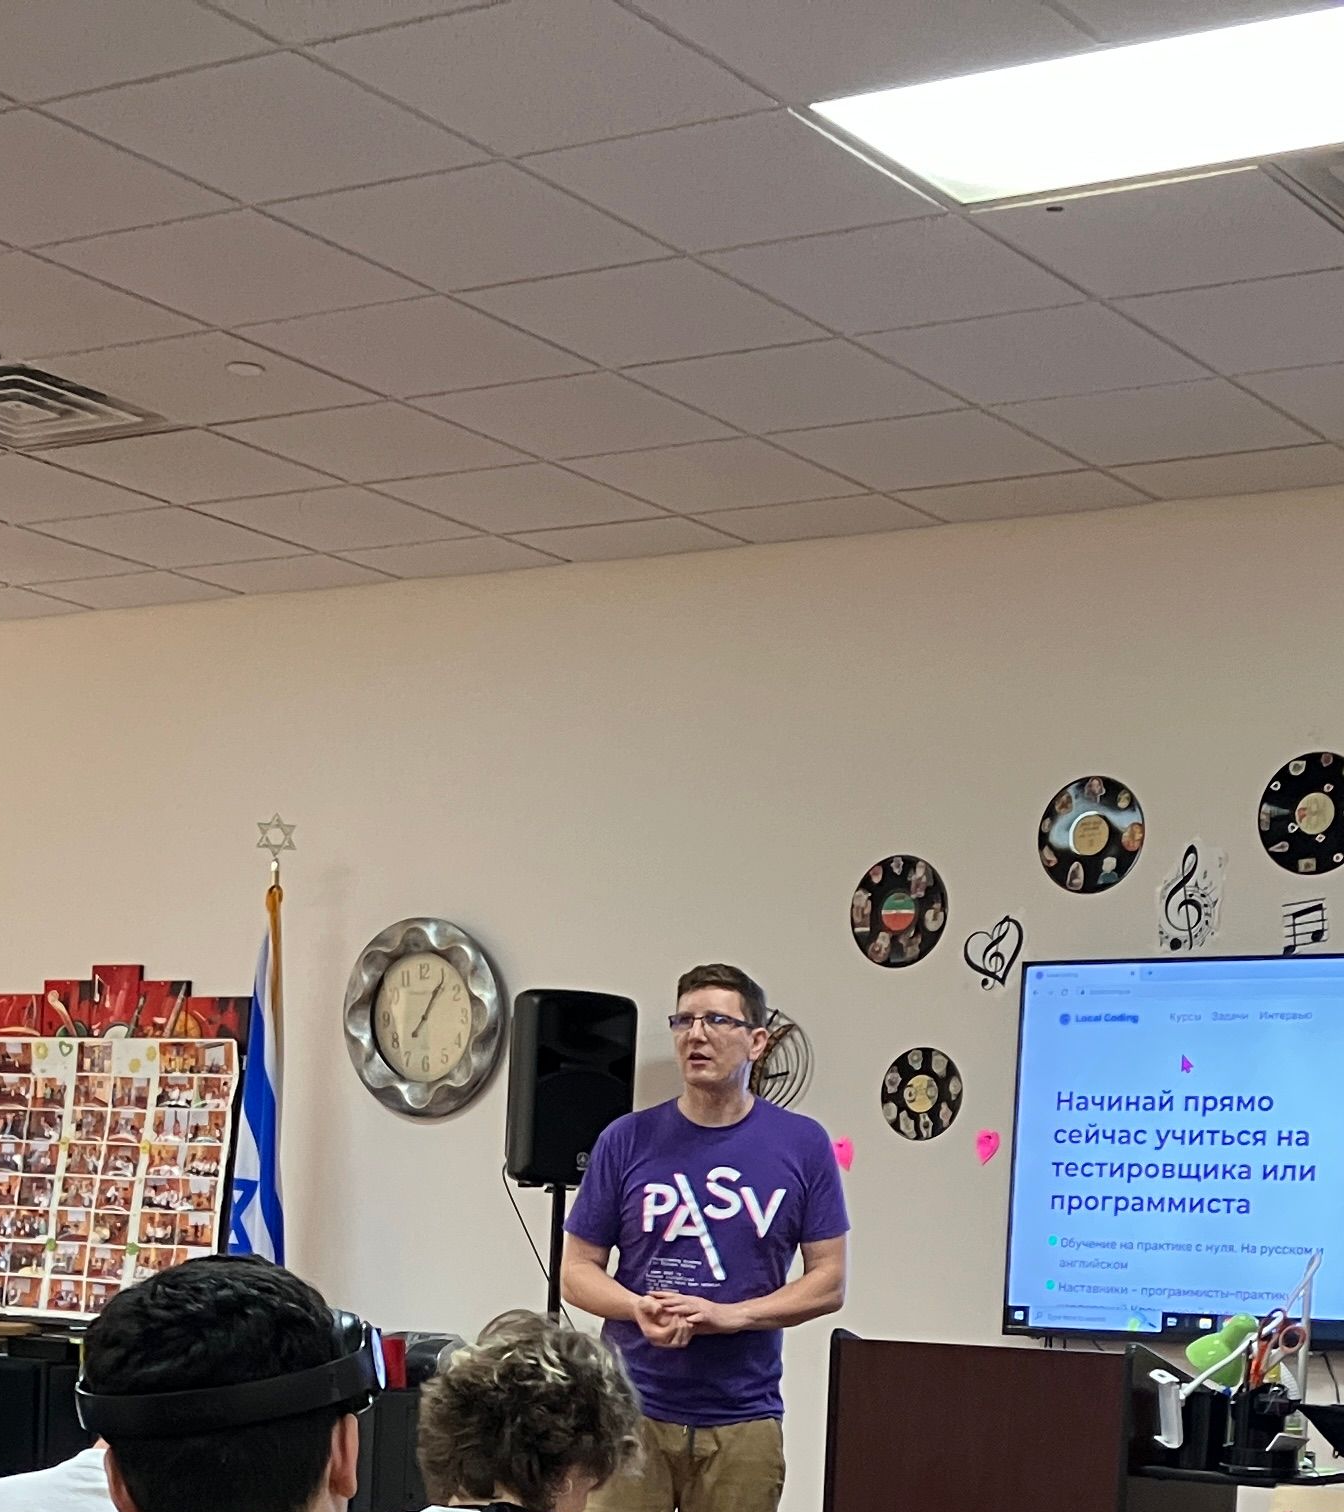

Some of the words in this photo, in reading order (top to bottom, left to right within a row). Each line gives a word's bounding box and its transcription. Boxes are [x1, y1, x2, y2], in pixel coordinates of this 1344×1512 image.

[401, 970, 410, 987] 11
[419, 963, 430, 980] 12
[452, 984, 461, 1001] 2
[382, 1010, 391, 1028] 9
[460, 1007, 468, 1024] 3
[391, 1031, 400, 1049] 8
[454, 1032, 462, 1049] 4
[404, 1050, 412, 1068] 7
[421, 1055, 430, 1073] 6
[440, 1048, 449, 1064] 5
[1056, 1089, 1174, 1113] Начинай
[1183, 1094, 1274, 1117] прямо
[1053, 1123, 1148, 1146] сейчас
[1154, 1128, 1267, 1151] учиться
[1277, 1130, 1311, 1147] на
[1051, 1160, 1252, 1183] тестировщика
[1261, 1163, 1316, 1182] или
[1050, 1194, 1251, 1217] программиста
[641, 1166, 787, 1281] PASV
[1060, 1236, 1117, 1253] Обучение
[1119, 1240, 1134, 1251] на
[1136, 1241, 1192, 1253] практике
[1195, 1243, 1203, 1253] с
[1241, 1242, 1257, 1254] На
[1259, 1245, 1313, 1257] русском
[1059, 1258, 1129, 1270] английском
[1058, 1282, 1129, 1295] Наставники
[1140, 1286, 1289, 1302] программисты-практик
